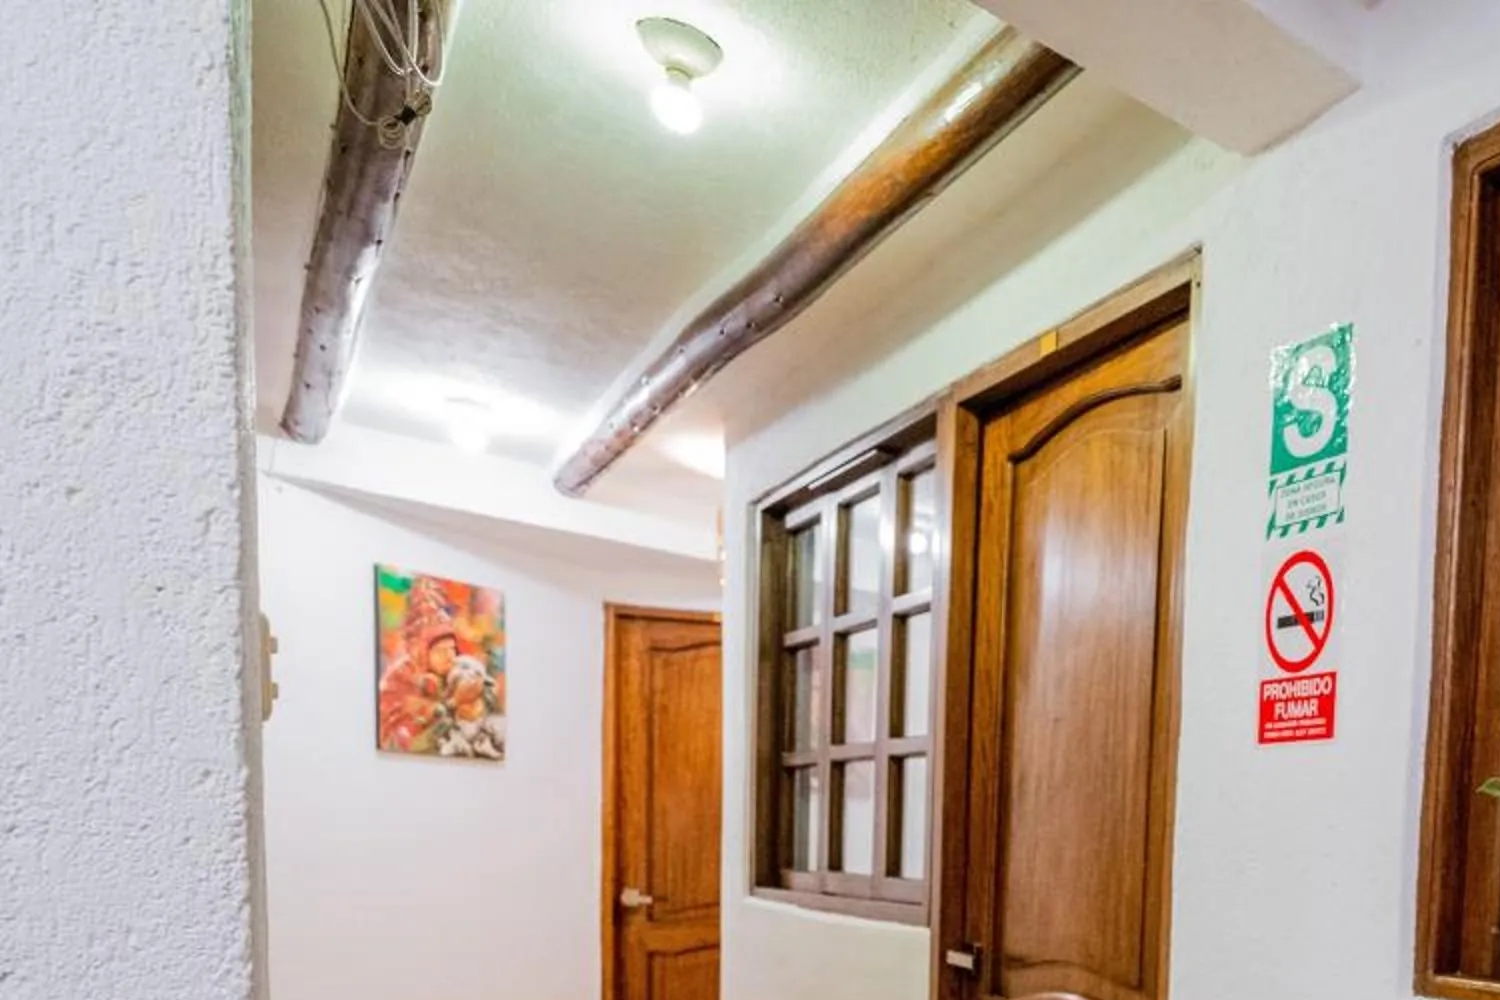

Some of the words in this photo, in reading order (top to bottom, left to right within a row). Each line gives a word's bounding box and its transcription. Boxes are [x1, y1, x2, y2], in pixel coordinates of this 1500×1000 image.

[1283, 345, 1338, 459] S
[1264, 675, 1333, 701] PROHIBIDO
[1275, 698, 1319, 720] FUMAR
